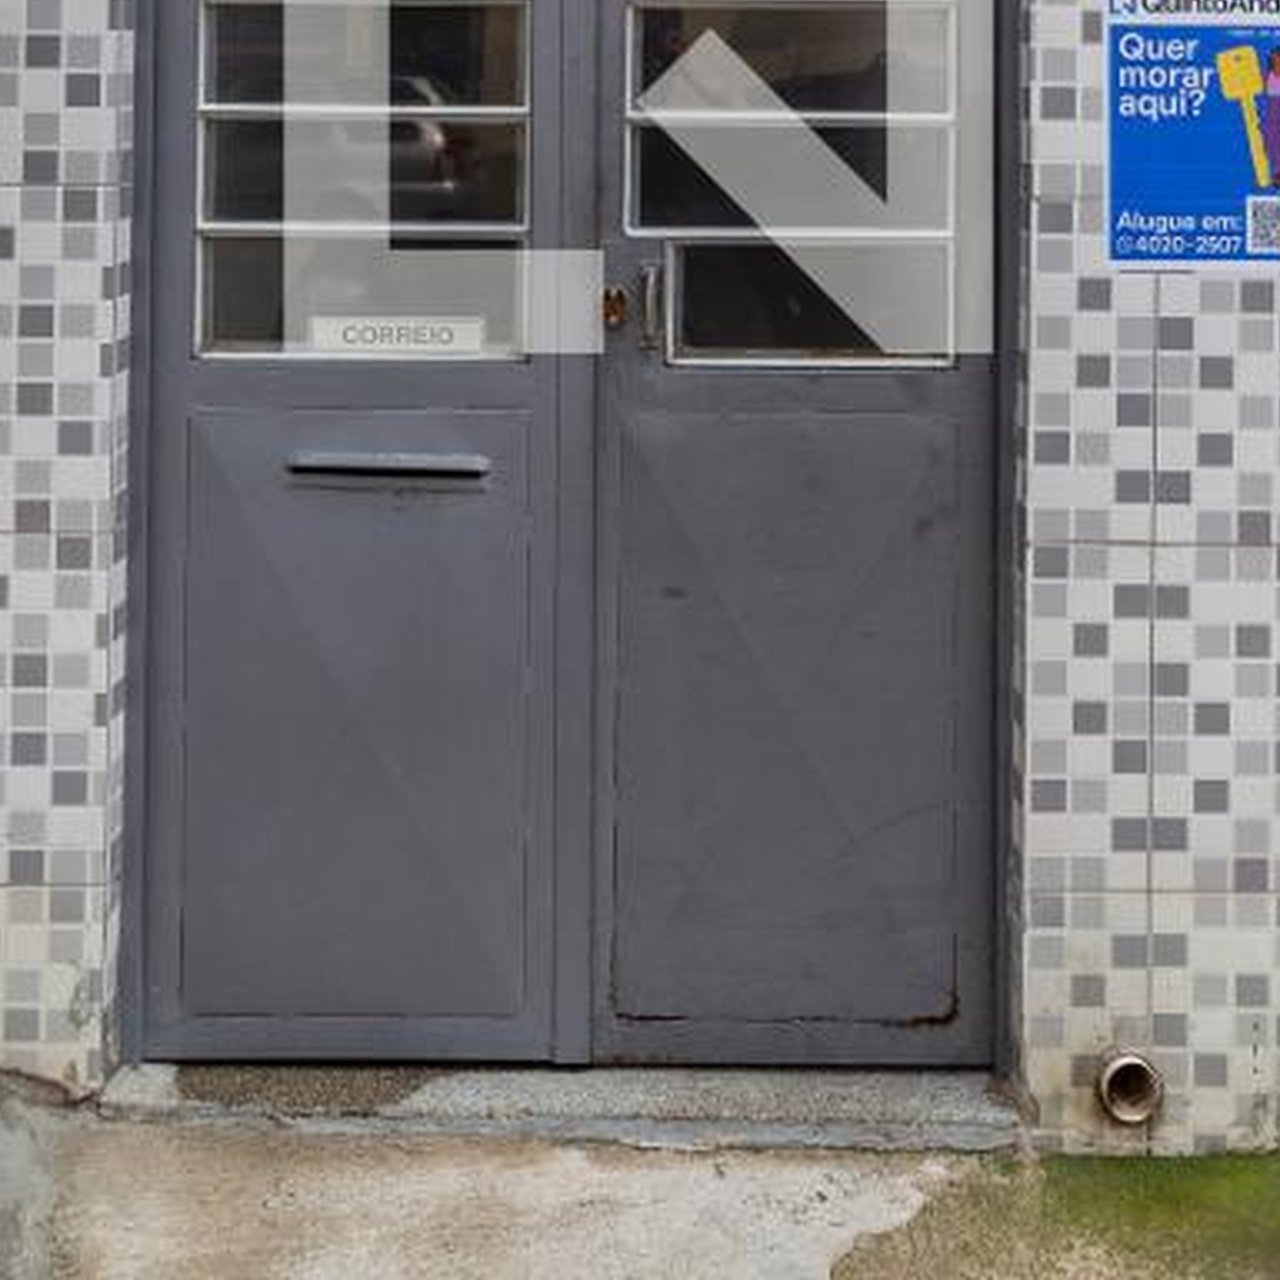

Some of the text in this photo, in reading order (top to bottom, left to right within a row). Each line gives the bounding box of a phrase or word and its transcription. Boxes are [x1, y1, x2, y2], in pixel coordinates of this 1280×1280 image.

[1119, 32, 1200, 61] Quer
[1119, 66, 1213, 88] morar
[1119, 89, 1205, 121] aqui?
[1116, 212, 1195, 234] Alugue
[343, 325, 455, 345] CORREIO
